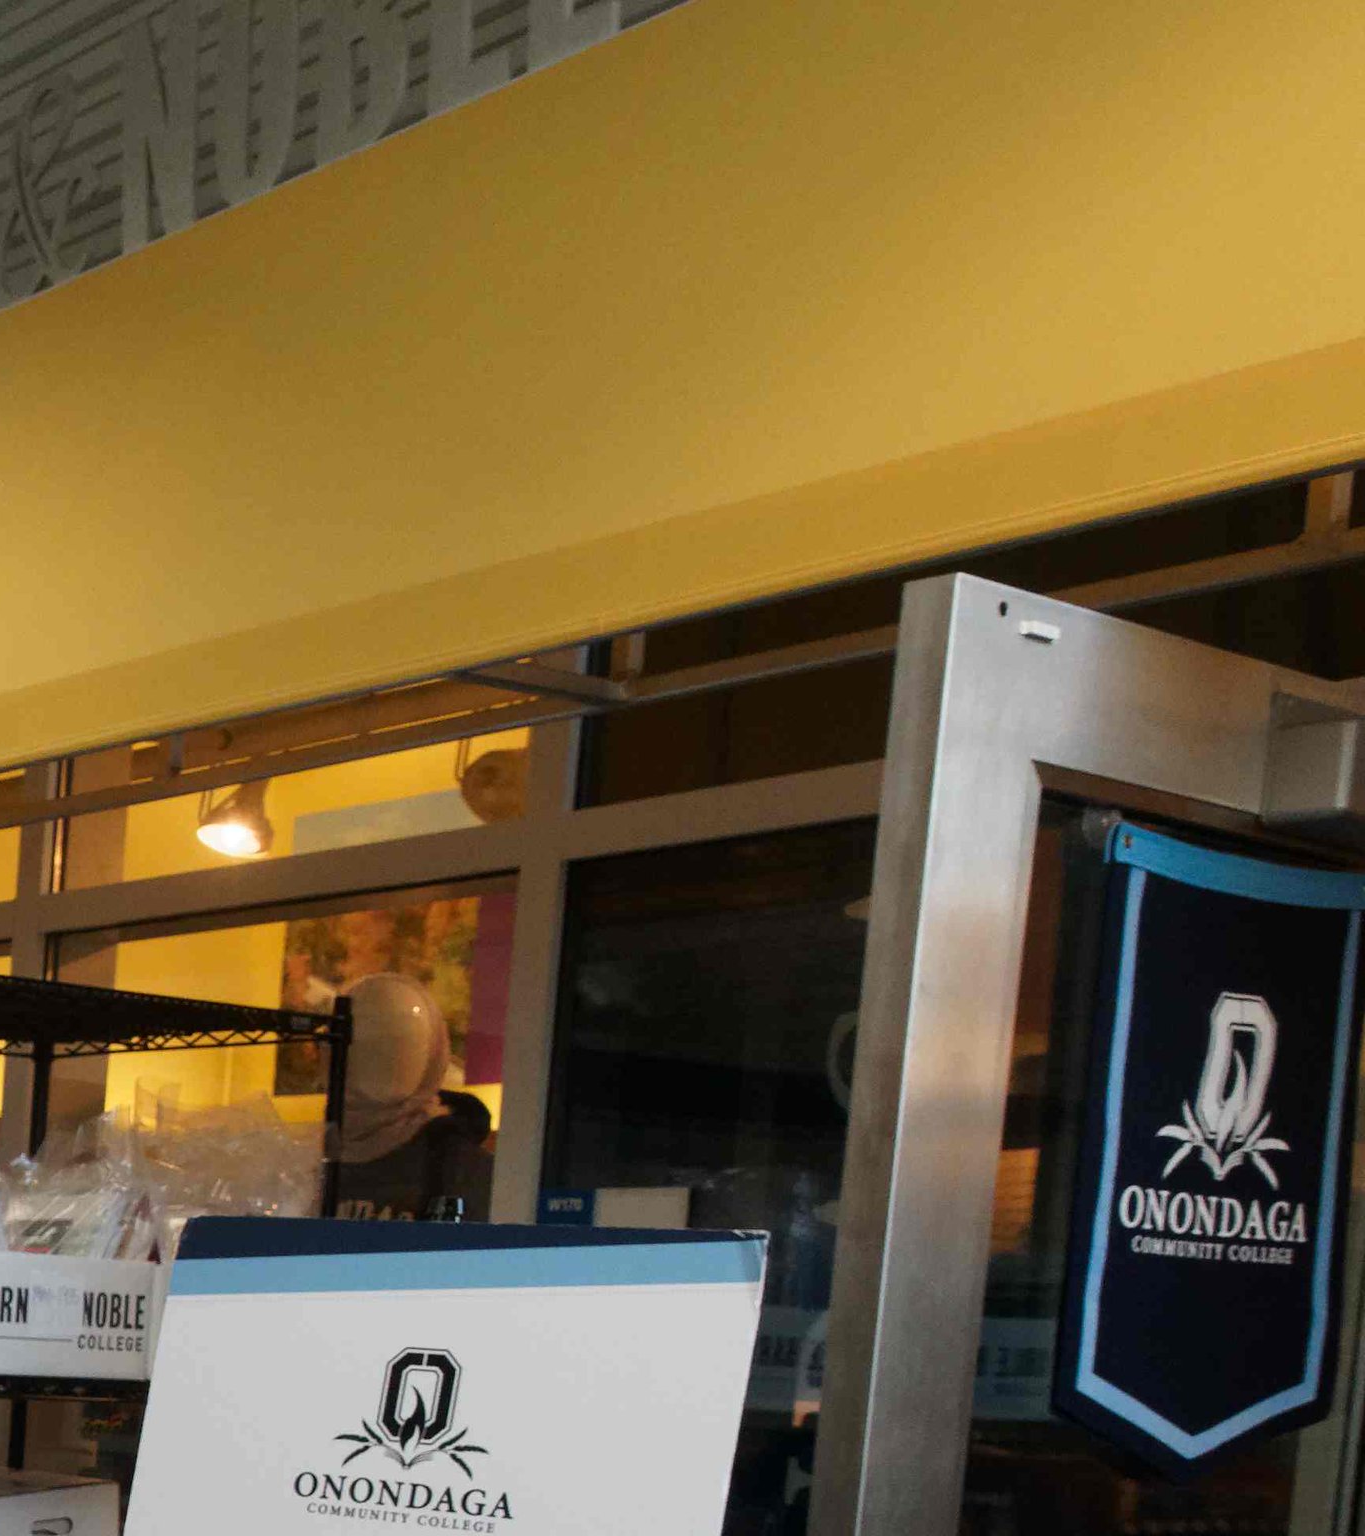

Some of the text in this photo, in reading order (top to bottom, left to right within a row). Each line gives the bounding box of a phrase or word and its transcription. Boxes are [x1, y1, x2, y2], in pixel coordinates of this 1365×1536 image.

[1118, 1183, 1309, 1244] ONONDAGA
[1130, 1235, 1295, 1264] COMMUNITY COLLEGE
[82, 1291, 146, 1330] NOBLE
[77, 1334, 143, 1352] COLLEGE
[293, 1471, 514, 1520] ONONDAGA
[306, 1502, 497, 1535] COMMUNITY COLLEGE
